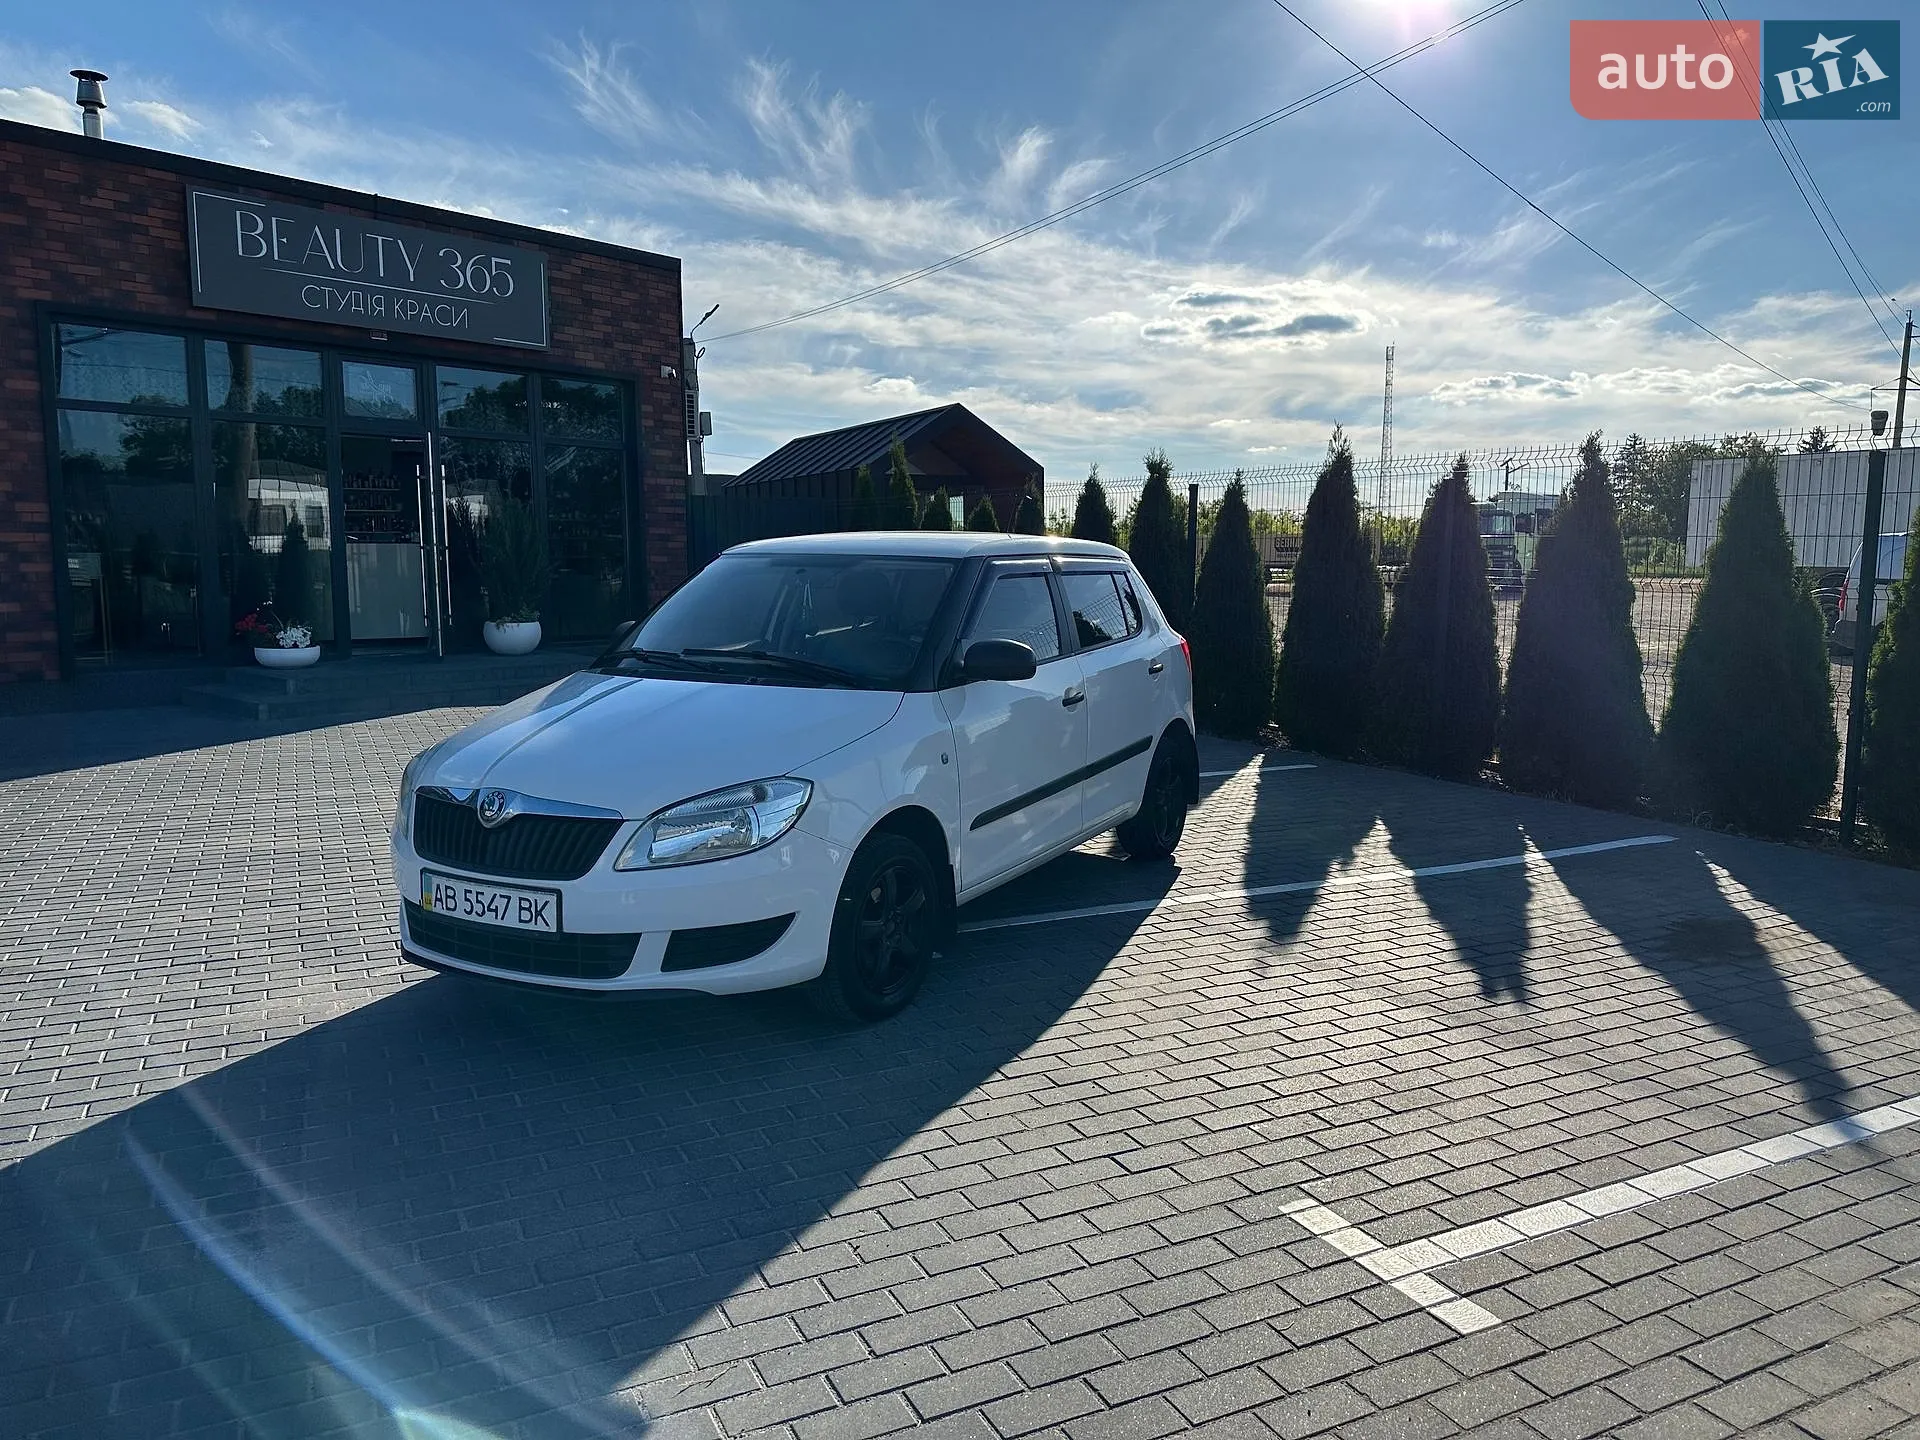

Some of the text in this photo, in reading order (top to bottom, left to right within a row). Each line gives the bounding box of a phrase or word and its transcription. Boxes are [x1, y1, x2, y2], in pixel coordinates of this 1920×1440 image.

[235, 210, 515, 298] BEAUTY 365
[301, 285, 469, 329] СТУДІЯ КРАСИ
[434, 884, 550, 928] AB 5547 BK
